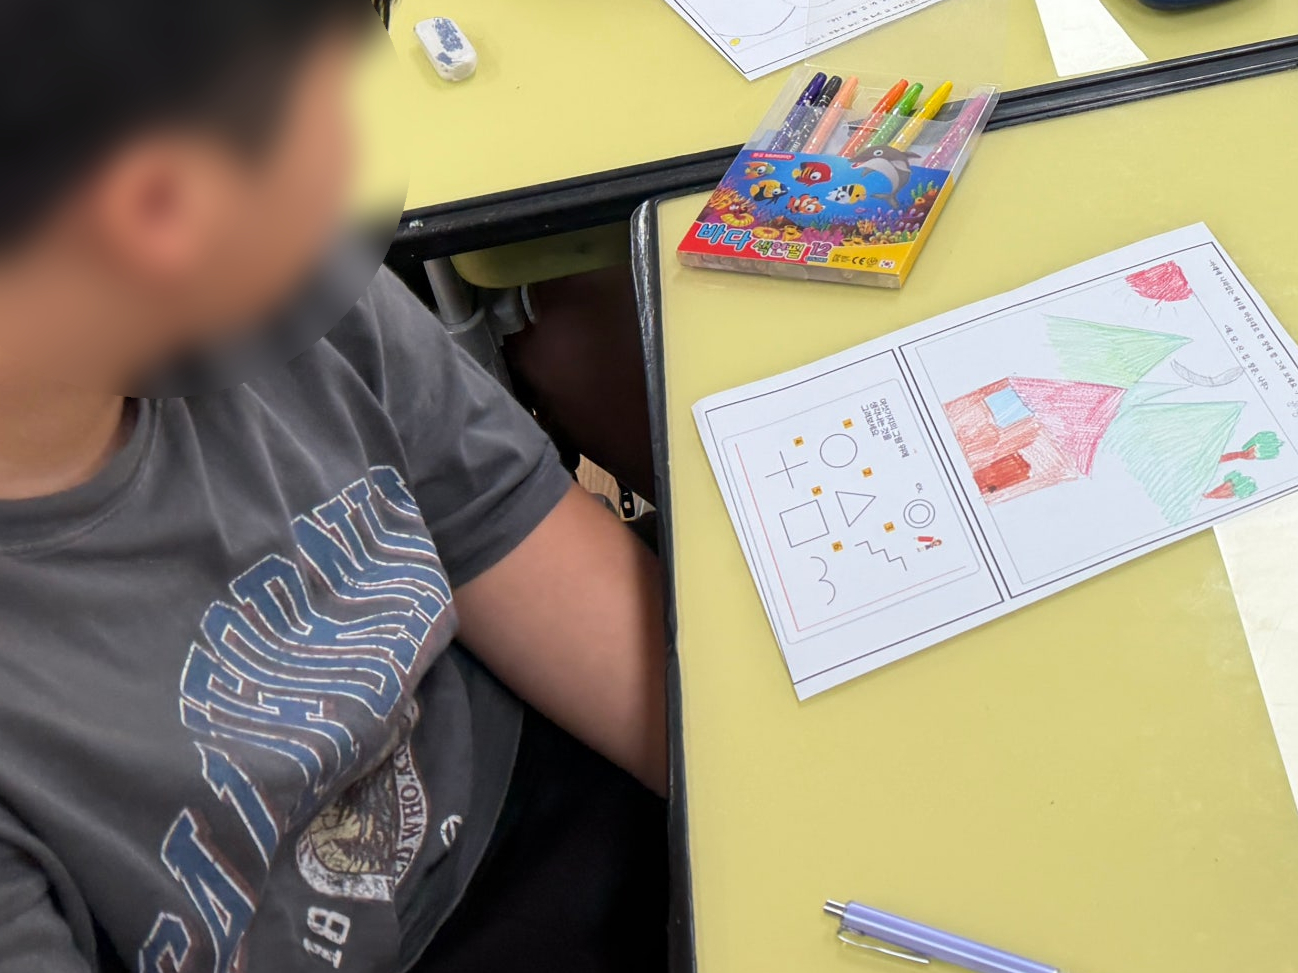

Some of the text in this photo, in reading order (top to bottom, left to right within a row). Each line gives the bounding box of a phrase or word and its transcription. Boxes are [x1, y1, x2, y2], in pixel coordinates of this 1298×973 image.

[697, 223, 752, 251] 바다
[752, 240, 833, 260] 색연필 12
